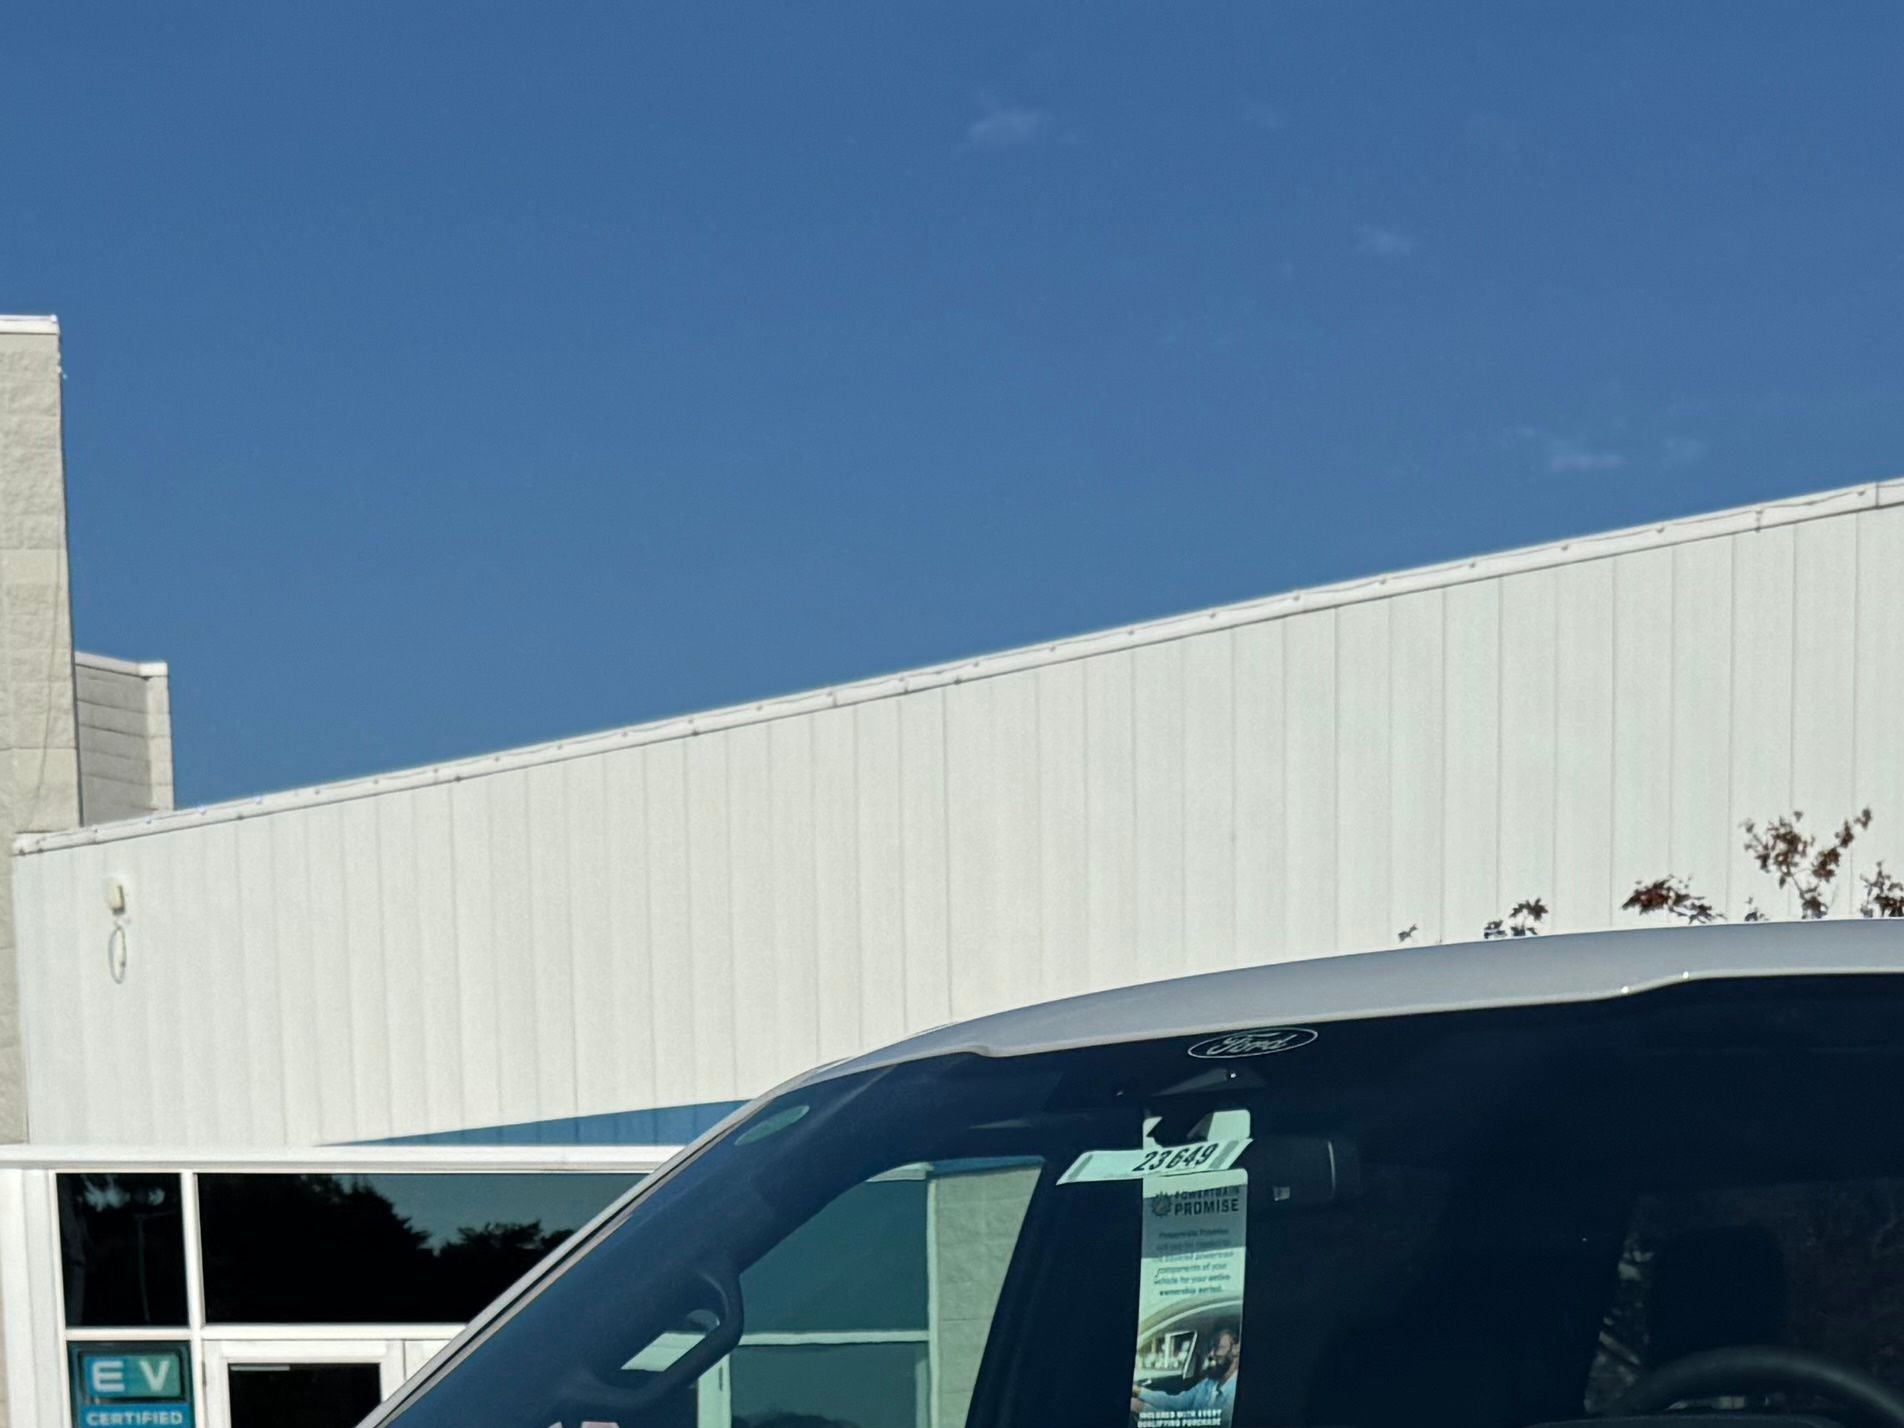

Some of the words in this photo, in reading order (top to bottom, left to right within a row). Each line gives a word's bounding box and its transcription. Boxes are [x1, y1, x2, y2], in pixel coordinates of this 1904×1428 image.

[1206, 1032, 1298, 1055] Ford
[1131, 1143, 1220, 1172] 23649
[1174, 1198, 1240, 1217] PROMISE
[86, 1411, 184, 1427] CERTIFIED
